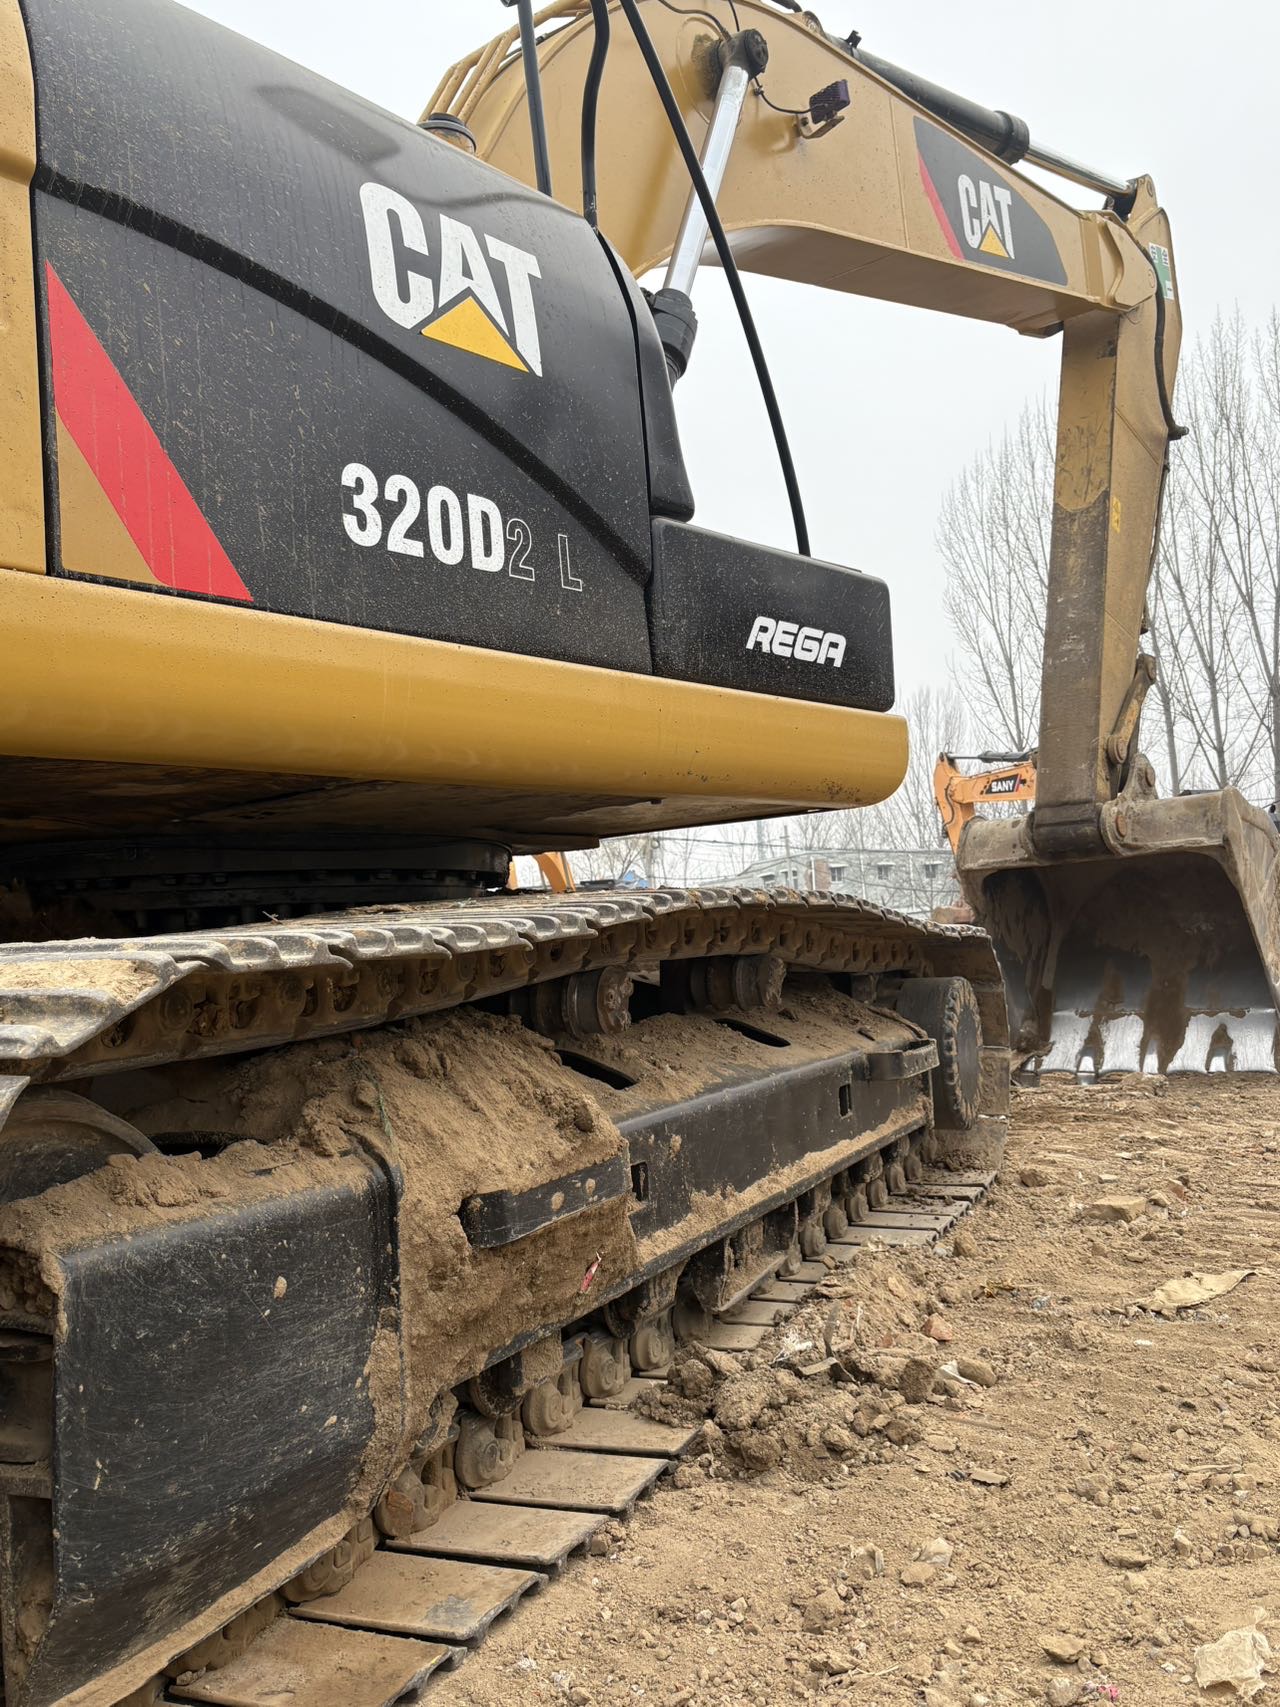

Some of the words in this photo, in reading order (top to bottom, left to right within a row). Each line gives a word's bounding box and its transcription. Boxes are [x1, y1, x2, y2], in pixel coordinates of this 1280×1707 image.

[958, 174, 1015, 260] CAT
[359, 181, 543, 378] CAT
[557, 534, 584, 592] L
[746, 616, 847, 668] REGA
[990, 779, 1015, 793] SANY
